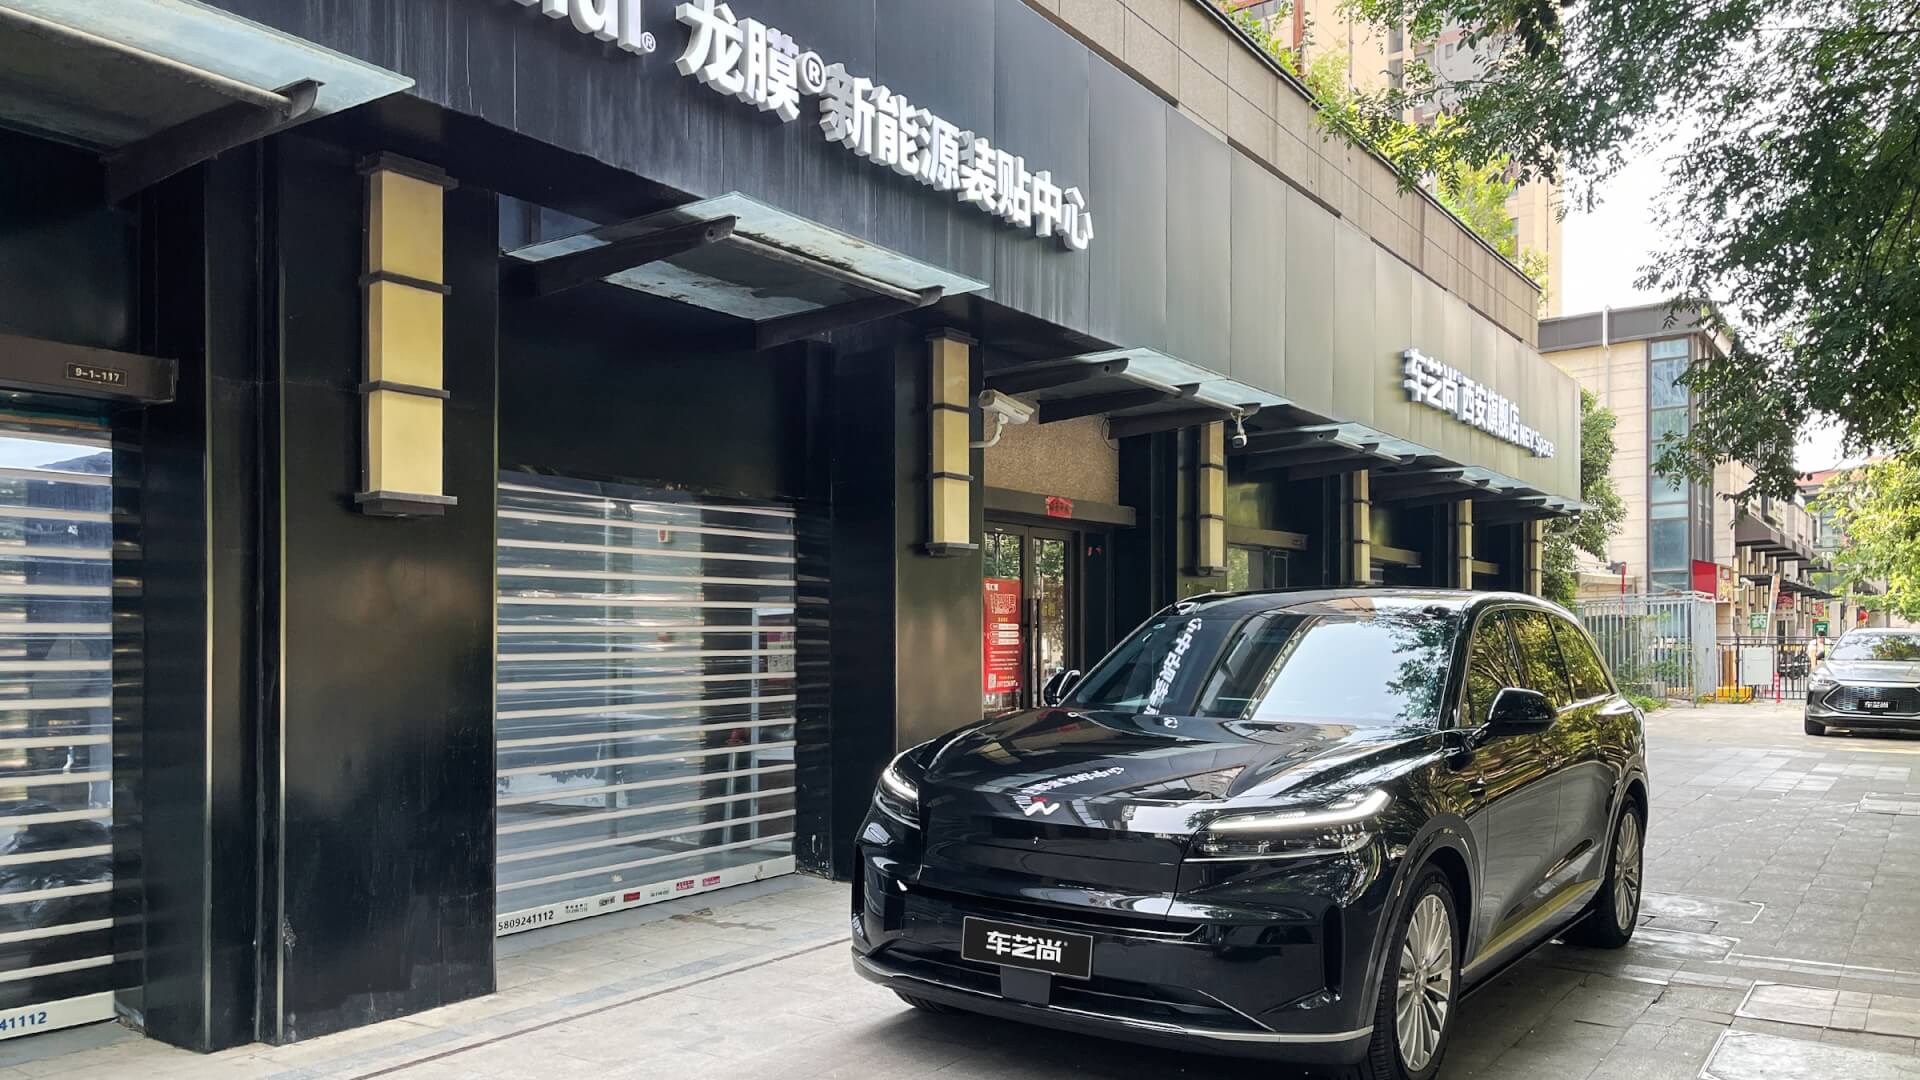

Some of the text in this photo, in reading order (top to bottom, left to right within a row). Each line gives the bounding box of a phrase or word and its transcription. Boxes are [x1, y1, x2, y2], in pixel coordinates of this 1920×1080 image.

[819, 62, 1093, 250] 新能源装贴中心
[75, 367, 120, 383] 9-1-117
[1403, 348, 1520, 445] 车艺尚 西安旗舰店
[498, 910, 554, 931] 5809241112
[985, 931, 1062, 963] 车艺尚
